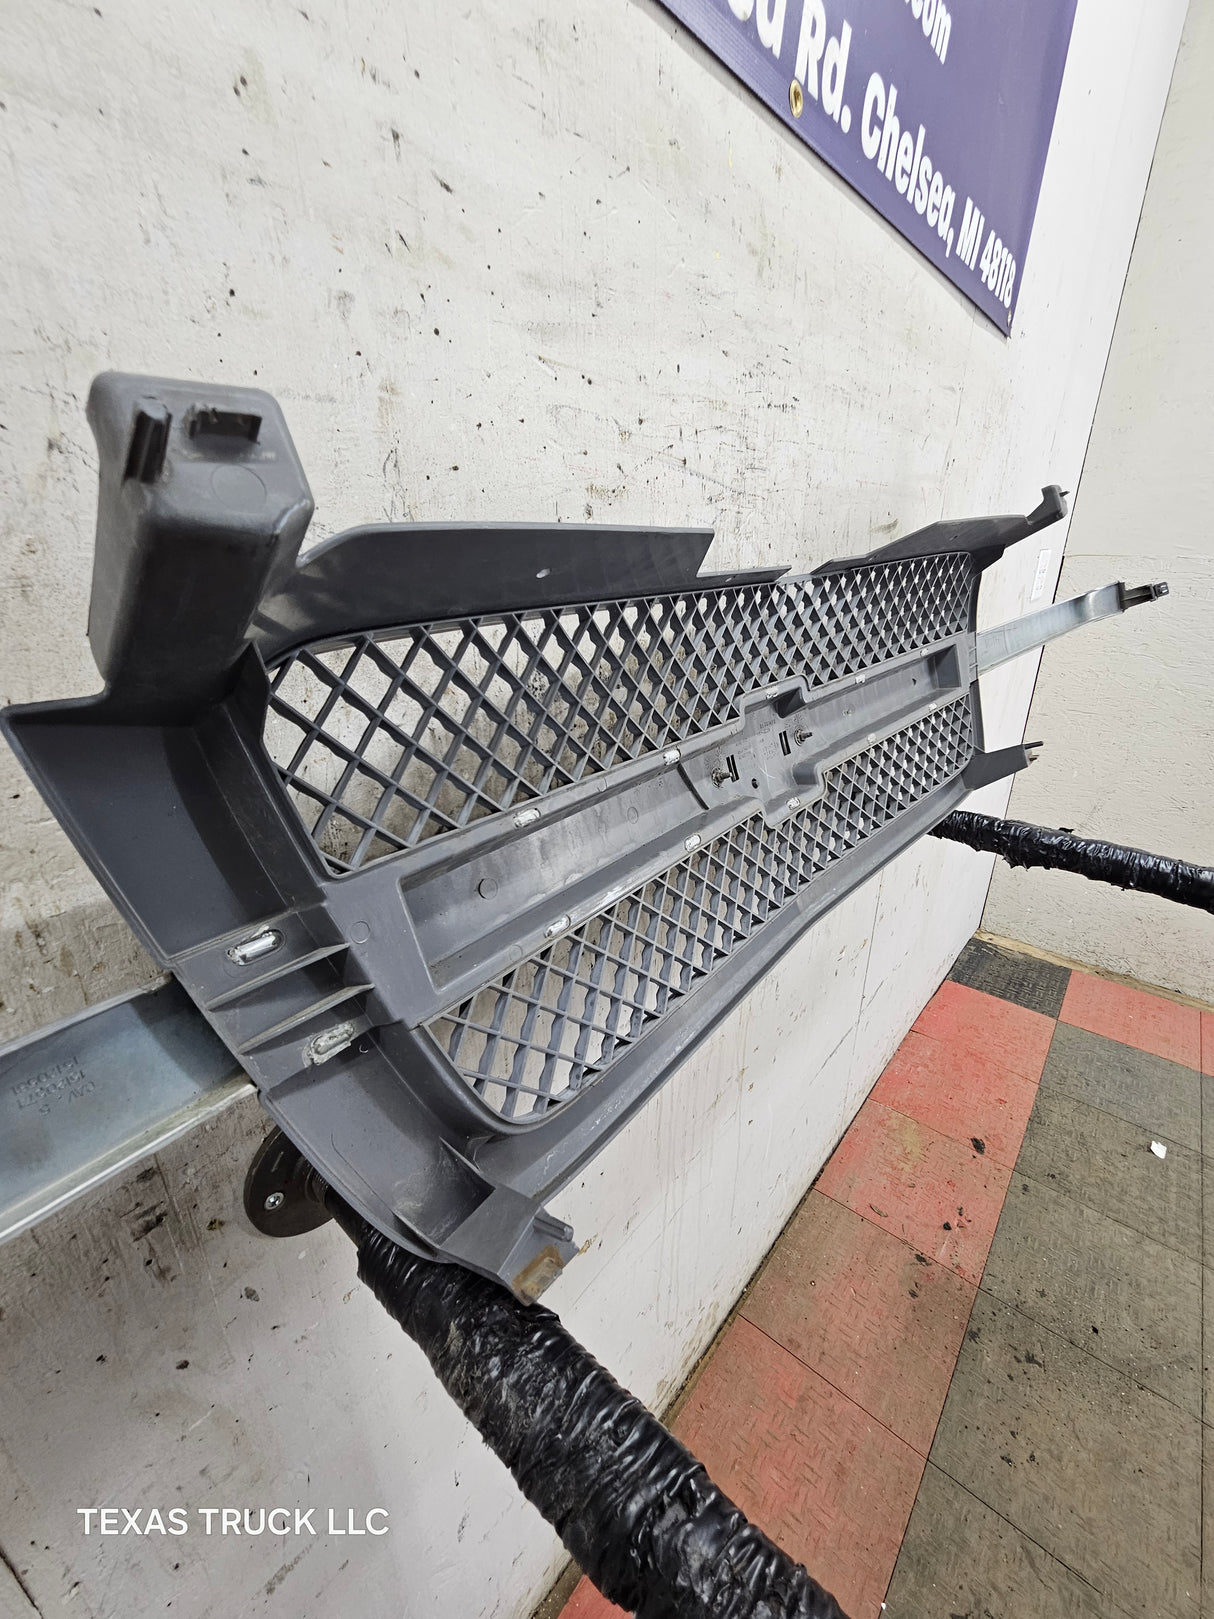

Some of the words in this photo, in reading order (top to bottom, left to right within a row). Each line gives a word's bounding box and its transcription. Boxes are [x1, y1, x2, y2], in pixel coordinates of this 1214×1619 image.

[794, 0, 852, 134] Rd.
[861, 72, 956, 258] Chelsea,
[955, 196, 986, 272] MI
[979, 229, 1017, 309] 48118
